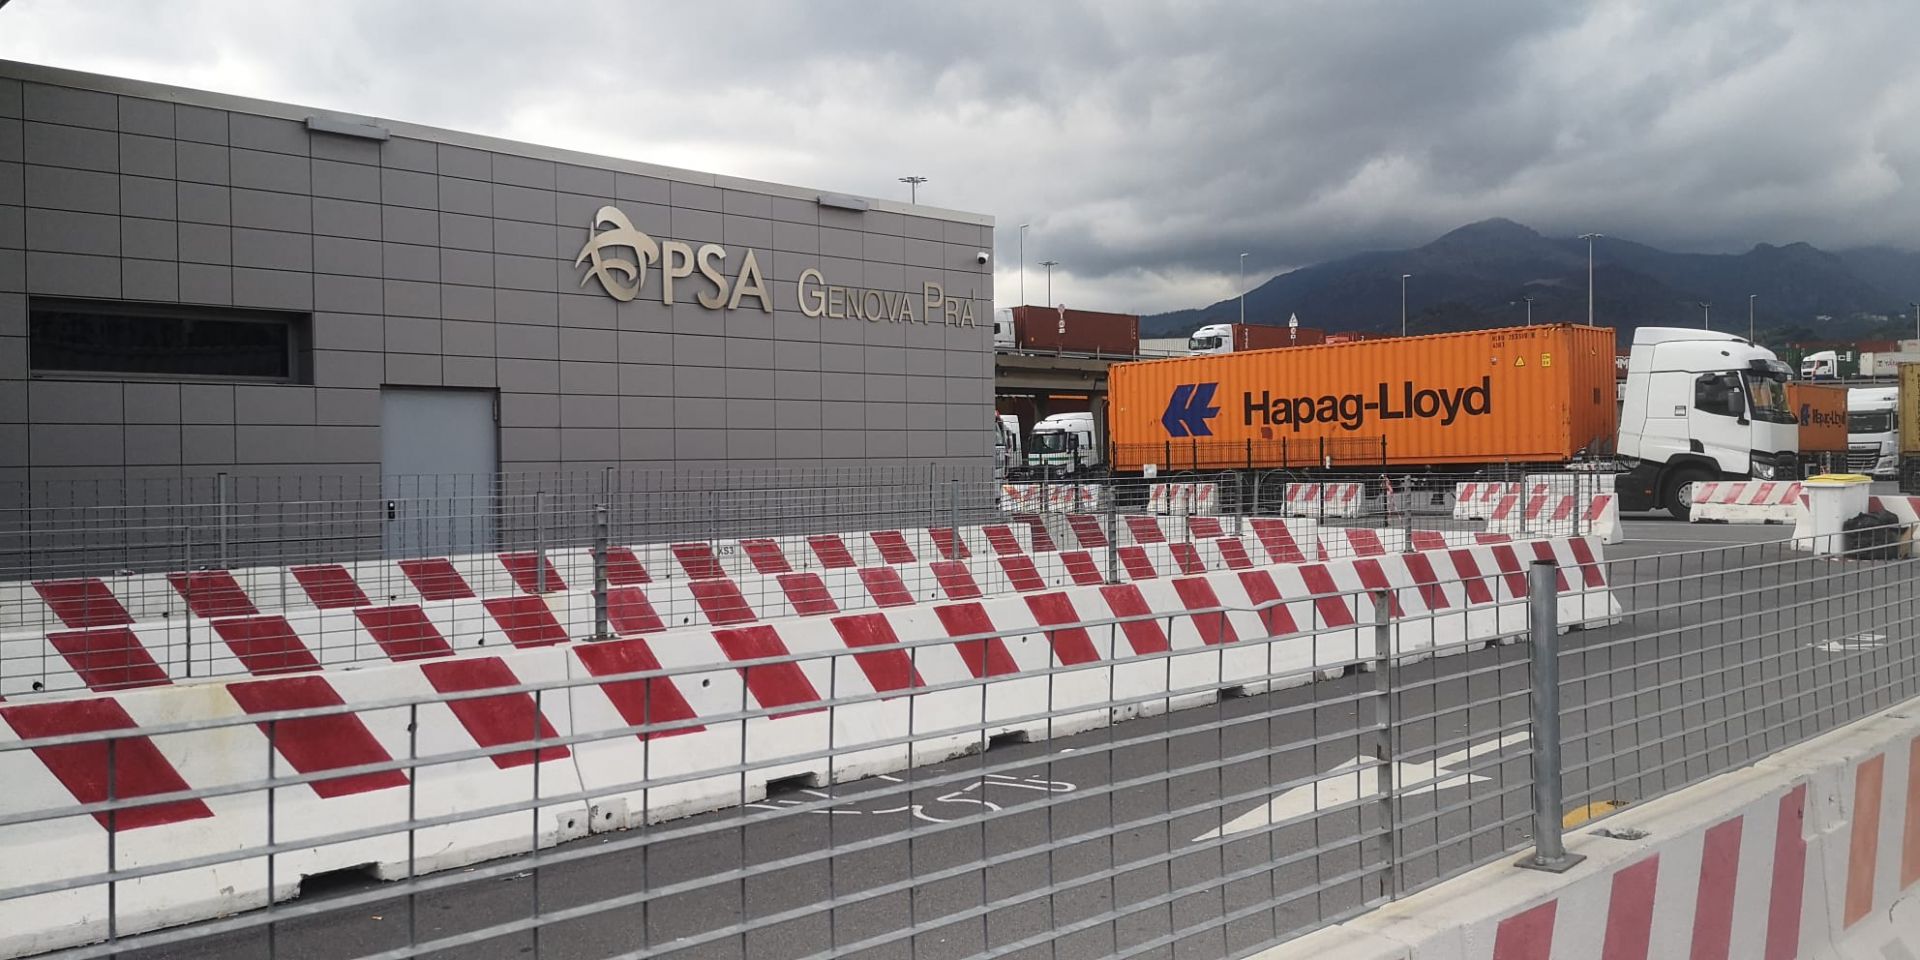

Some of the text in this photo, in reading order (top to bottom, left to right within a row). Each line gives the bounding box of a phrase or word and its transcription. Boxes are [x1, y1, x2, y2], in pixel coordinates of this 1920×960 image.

[661, 240, 773, 313] PSA
[797, 268, 914, 324] GENOVA
[1244, 375, 1491, 432] Hapag-Lloyd
